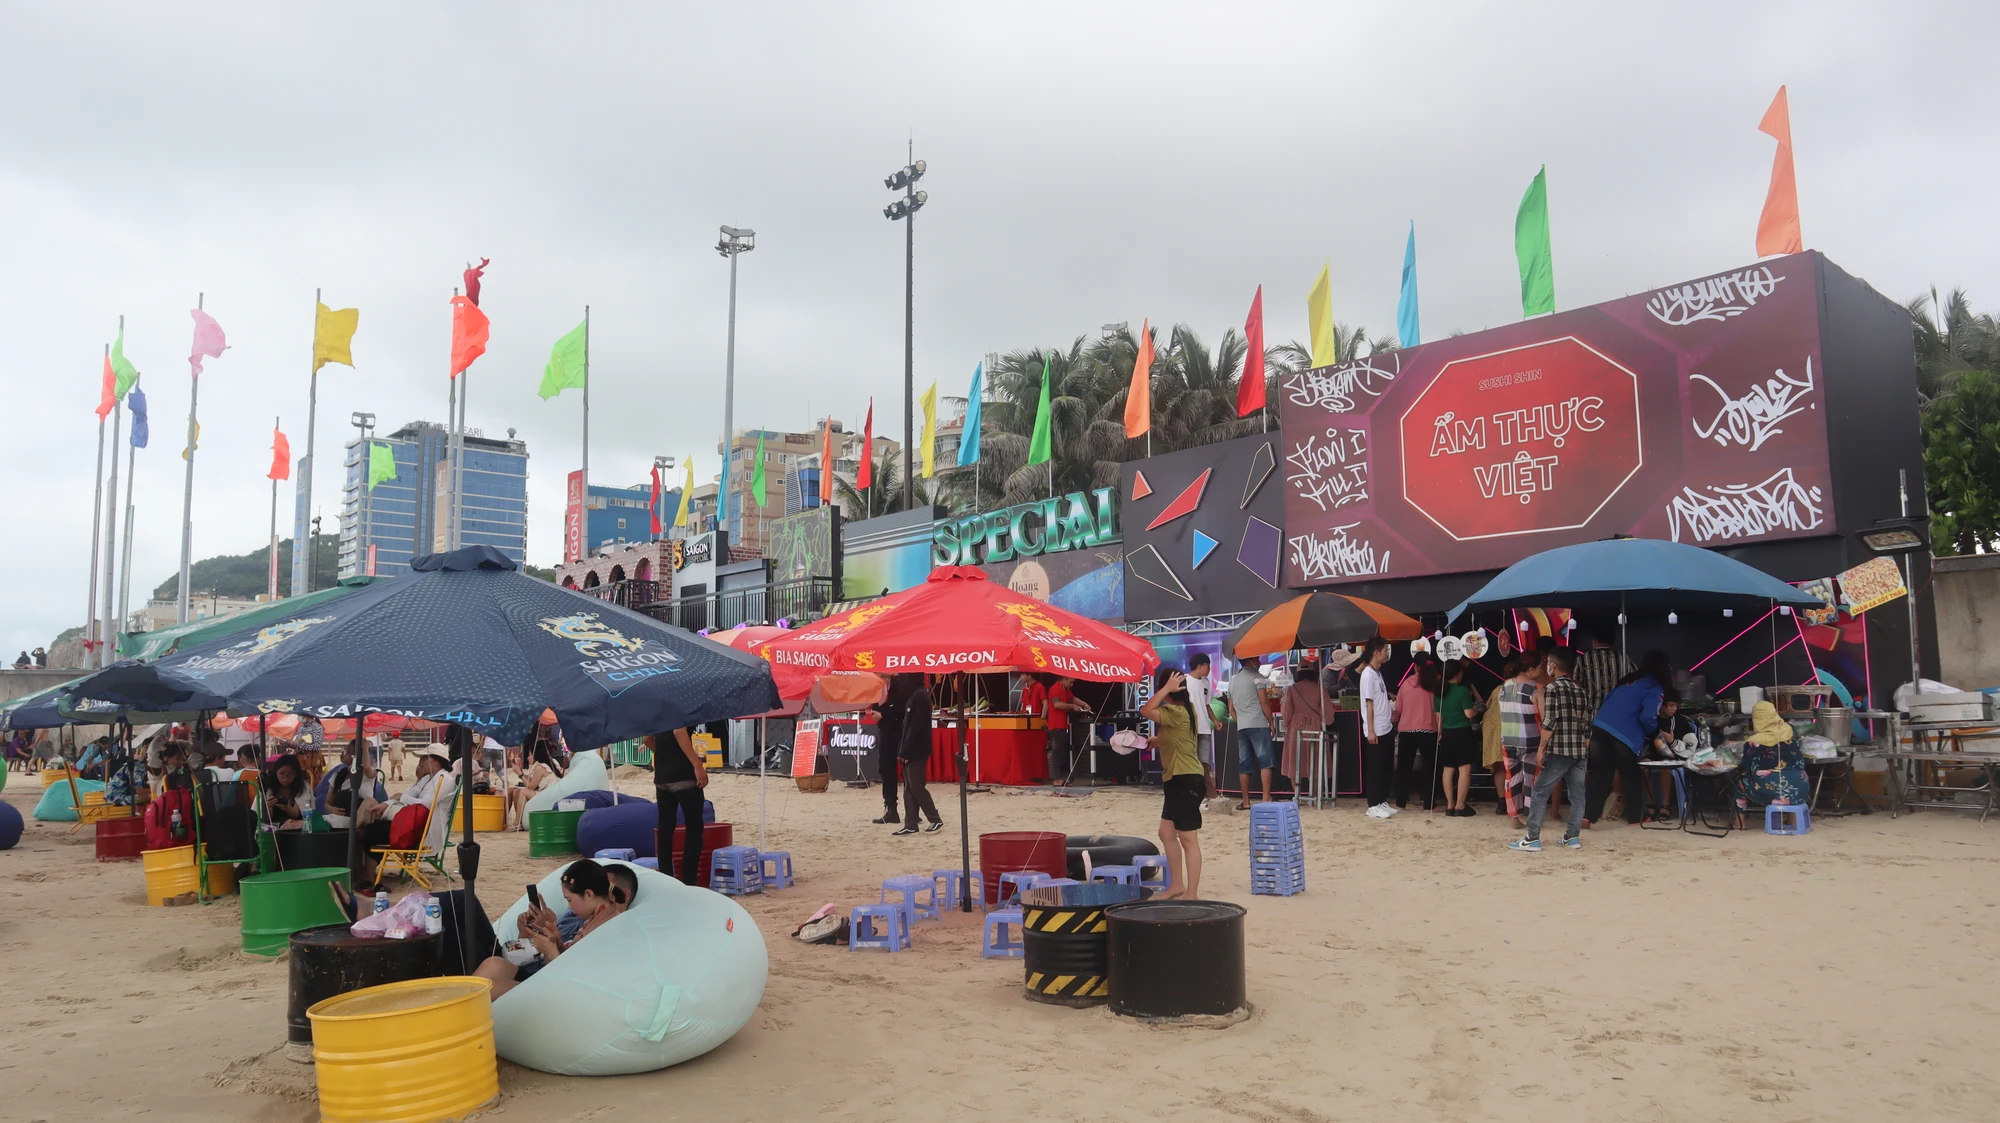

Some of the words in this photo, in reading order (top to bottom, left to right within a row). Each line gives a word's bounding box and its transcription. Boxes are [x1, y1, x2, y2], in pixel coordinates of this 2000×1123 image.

[1479, 374, 1512, 391] SUSHI
[1514, 368, 1543, 384] SHIN
[464, 426, 485, 438] EARL
[1430, 411, 1486, 457] ẨM
[1493, 396, 1605, 448] THỰC
[1473, 451, 1558, 504] VIỆT
[570, 512, 579, 561] IGON
[933, 486, 1123, 566] SPECIAL
[686, 543, 708, 556] SAIGON
[579, 650, 678, 673] SAIGON
[600, 648, 632, 658] BIA
[776, 650, 793, 664] BIA
[793, 651, 830, 668] SAIGON
[886, 654, 921, 668] BIA
[925, 650, 996, 667] SAIGON
[608, 664, 681, 681] CHILL
[1051, 655, 1080, 672] BIA
[1080, 659, 1133, 677] SAIGON
